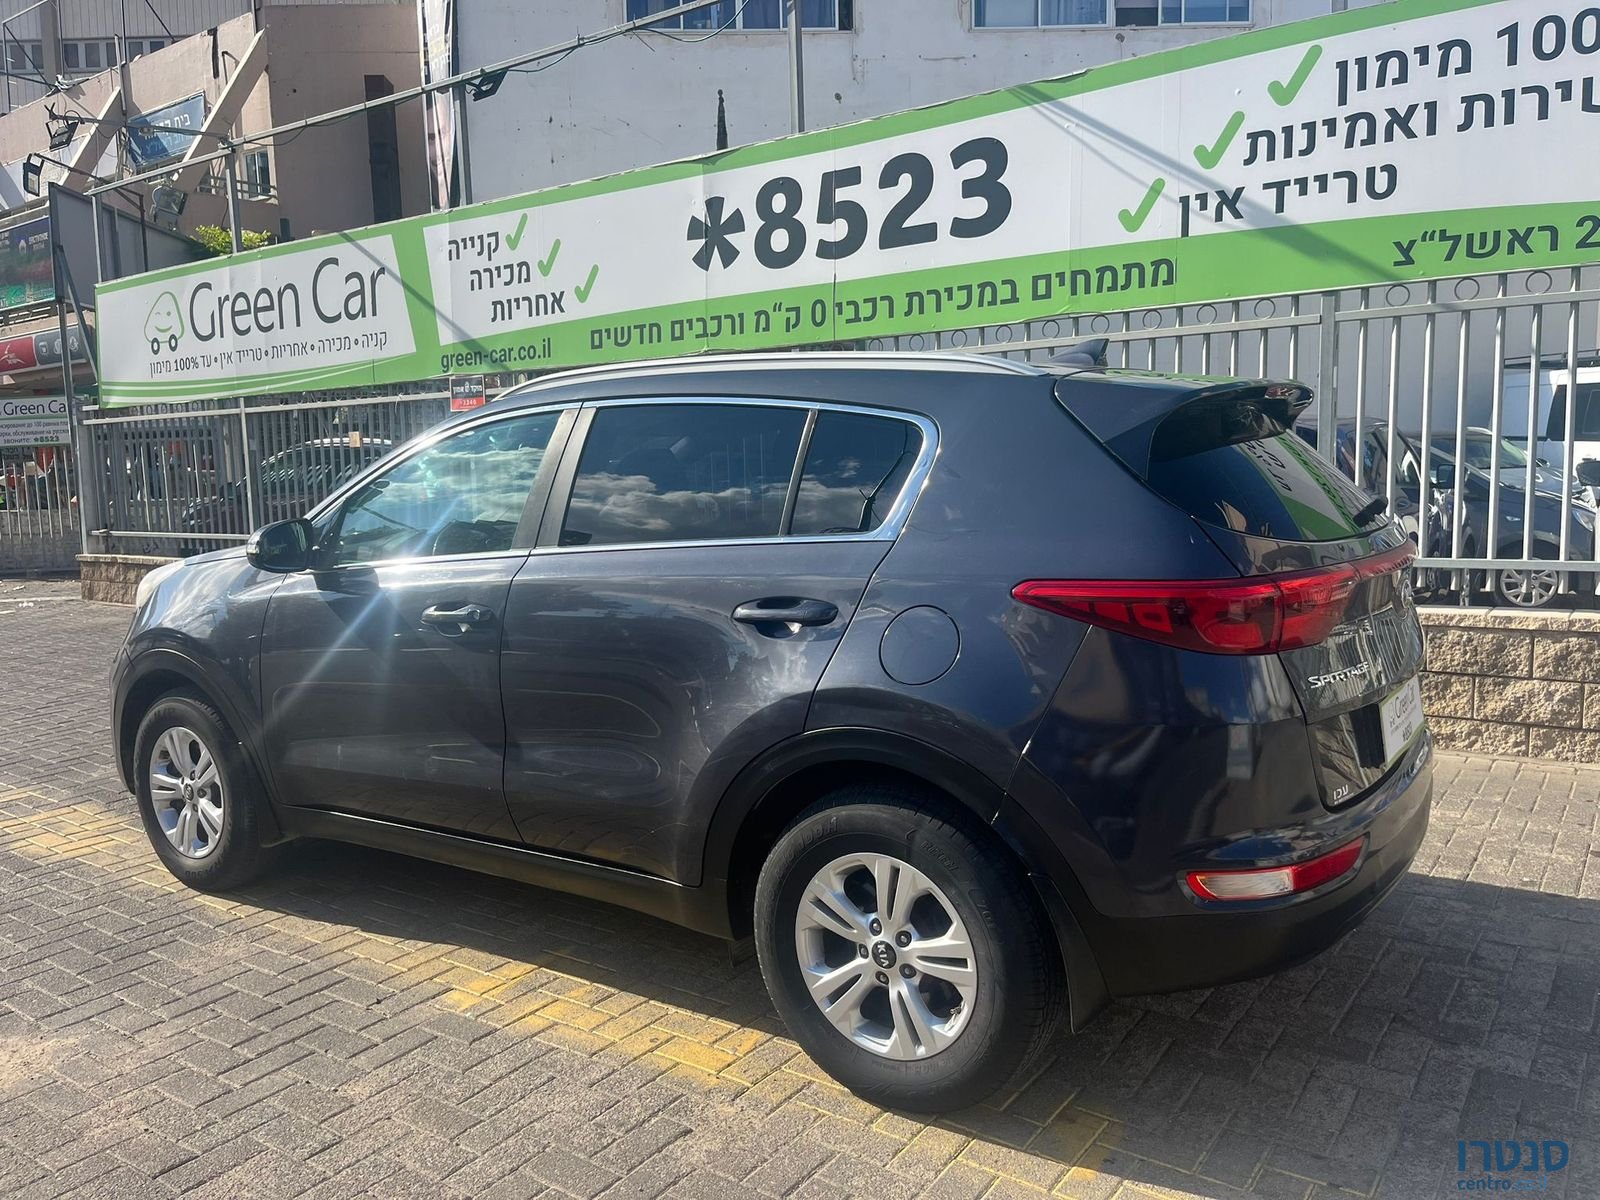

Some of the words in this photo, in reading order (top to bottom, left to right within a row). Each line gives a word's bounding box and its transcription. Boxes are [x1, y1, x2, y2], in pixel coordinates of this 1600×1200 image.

[1496, 7, 1600, 67] 100
[1335, 38, 1472, 107] מימון
[1242, 100, 1438, 167] ואמינות
[1262, 163, 1398, 214] טרייד
[1178, 186, 1246, 239] אין
[448, 231, 499, 262] קנייה
[469, 261, 531, 291] מכירה
[1031, 257, 1175, 301] מתמחים
[189, 281, 301, 342] Green
[311, 257, 386, 324] Car
[491, 290, 565, 323] אחריות
[836, 295, 895, 324] רכבי
[904, 278, 1020, 317] במכירת
[362, 331, 387, 351] קניה
[590, 322, 662, 350] חדשים
[670, 312, 745, 341] ורכבים
[236, 347, 263, 364] טרייד
[271, 342, 308, 360] אחריות
[318, 336, 351, 354] מכירה
[441, 337, 552, 373] green-car.co.il
[150, 360, 171, 379] מימון
[174, 356, 199, 372] 100%
[200, 355, 212, 368] עד
[220, 352, 233, 370] אין
[3, 402, 45, 416] Green
[1307, 661, 1369, 689] SPORTAGE
[877, 944, 890, 967] KIA
